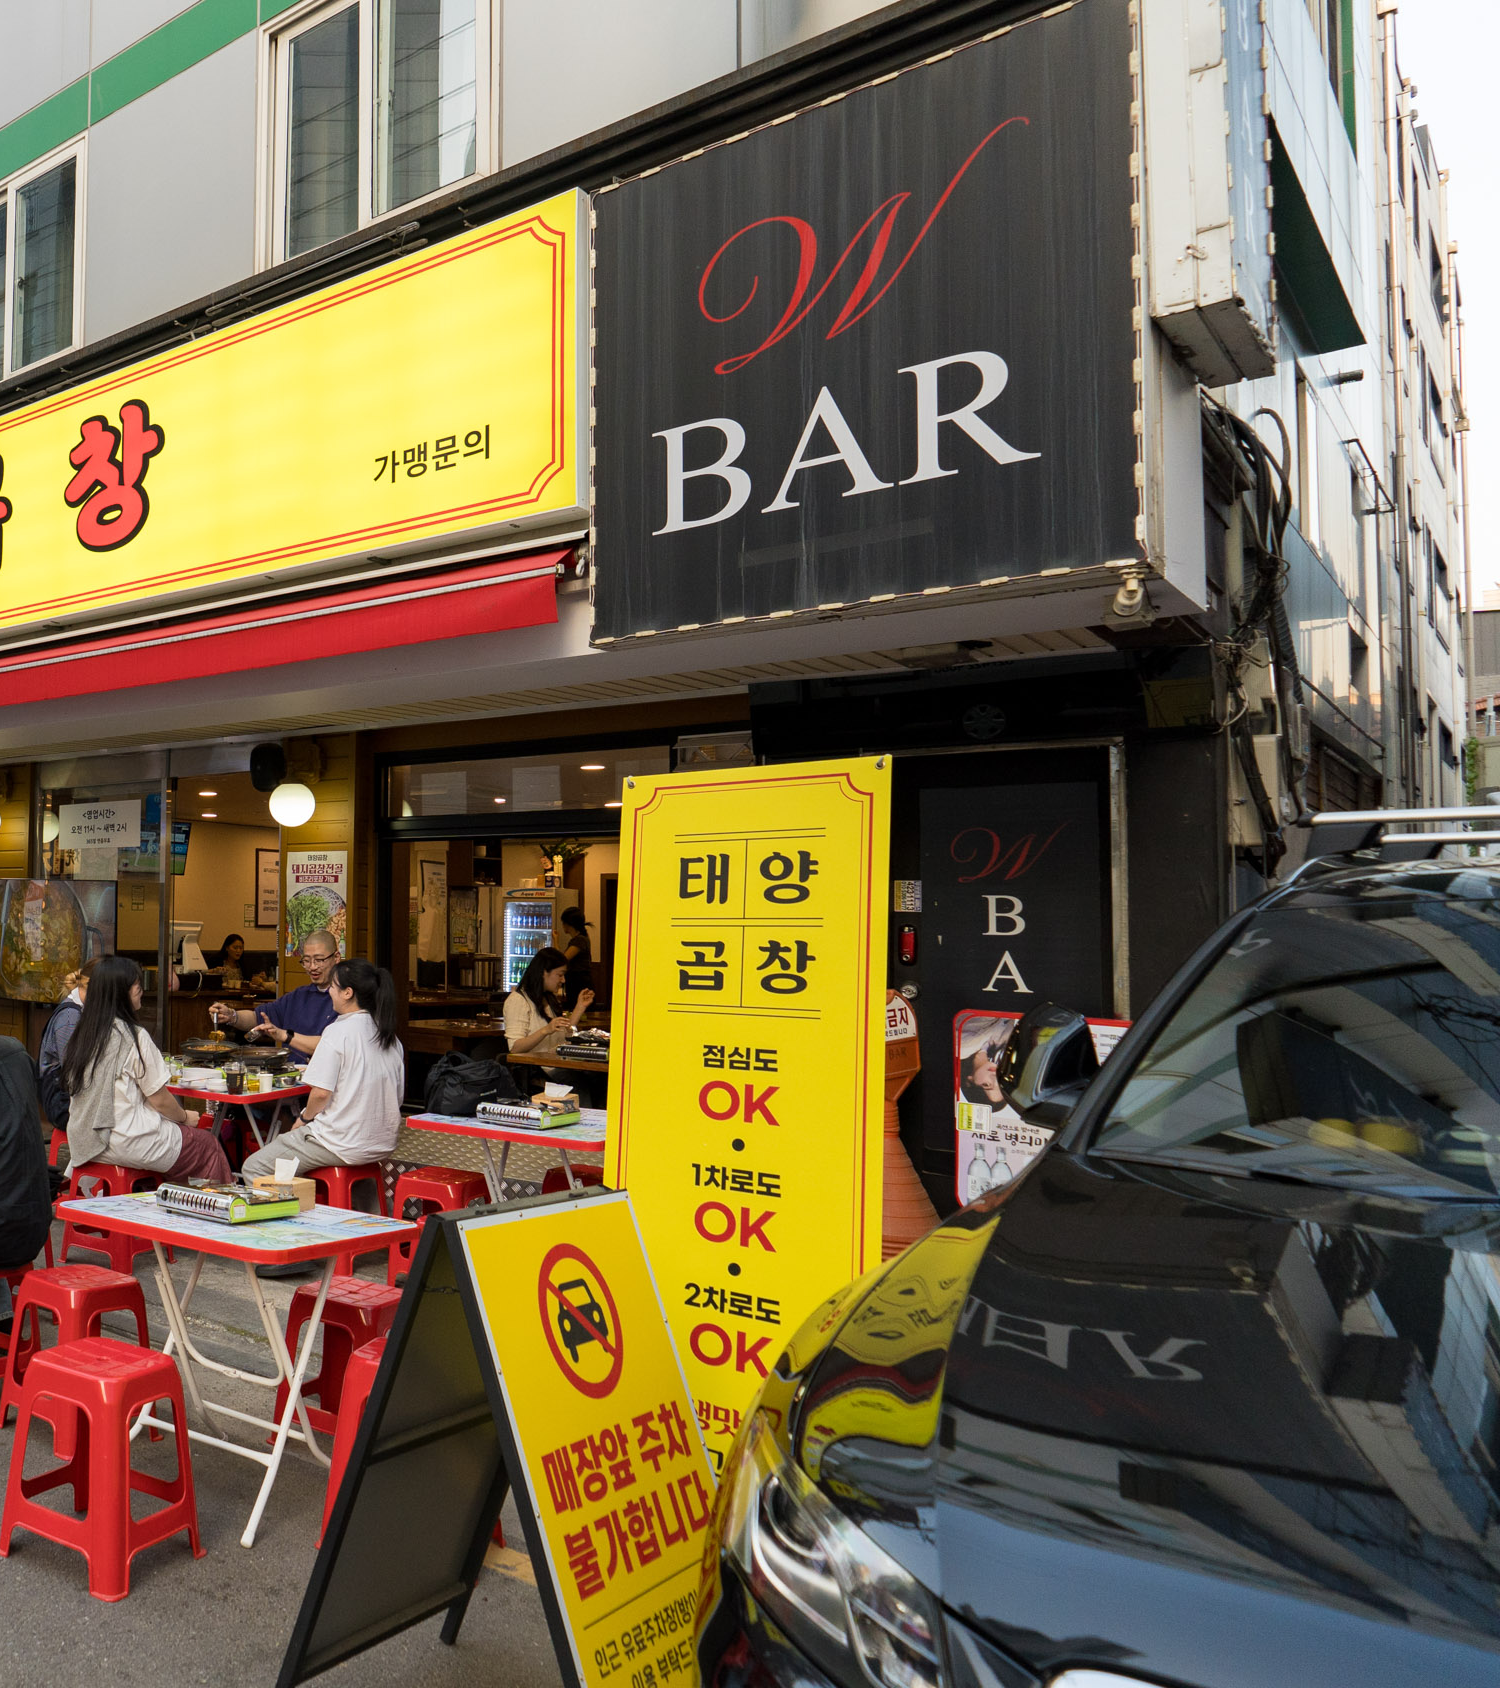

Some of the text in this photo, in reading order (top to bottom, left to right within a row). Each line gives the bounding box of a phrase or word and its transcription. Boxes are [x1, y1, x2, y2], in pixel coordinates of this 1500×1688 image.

[698, 115, 1030, 376] W
[373, 424, 491, 484] 가맹문의
[651, 350, 1042, 536] BAR
[71, 823, 83, 834] 오전
[83, 824, 96, 834] 11시
[103, 823, 115, 833] 새벽
[116, 822, 127, 832] 2시
[82, 808, 116, 820] <영업시간>
[291, 863, 343, 875] 돼지곱창전골
[307, 854, 328, 862] 태양곱창
[677, 849, 820, 905] 태양
[950, 820, 1068, 884] W
[675, 939, 817, 995] 곱창
[981, 894, 1034, 994] BA
[885, 1006, 910, 1029] 금지
[702, 1044, 779, 1073] 점심도
[698, 1080, 781, 1128] OK
[690, 1162, 782, 1199] 1차로도
[693, 1200, 777, 1254] OK
[683, 1282, 782, 1325] 2차로도
[688, 1323, 774, 1379] OK
[541, 1423, 637, 1516] 매장앞
[631, 1400, 693, 1474] 주차
[563, 1469, 711, 1602] 불가합니다
[594, 1640, 623, 1679] 인근
